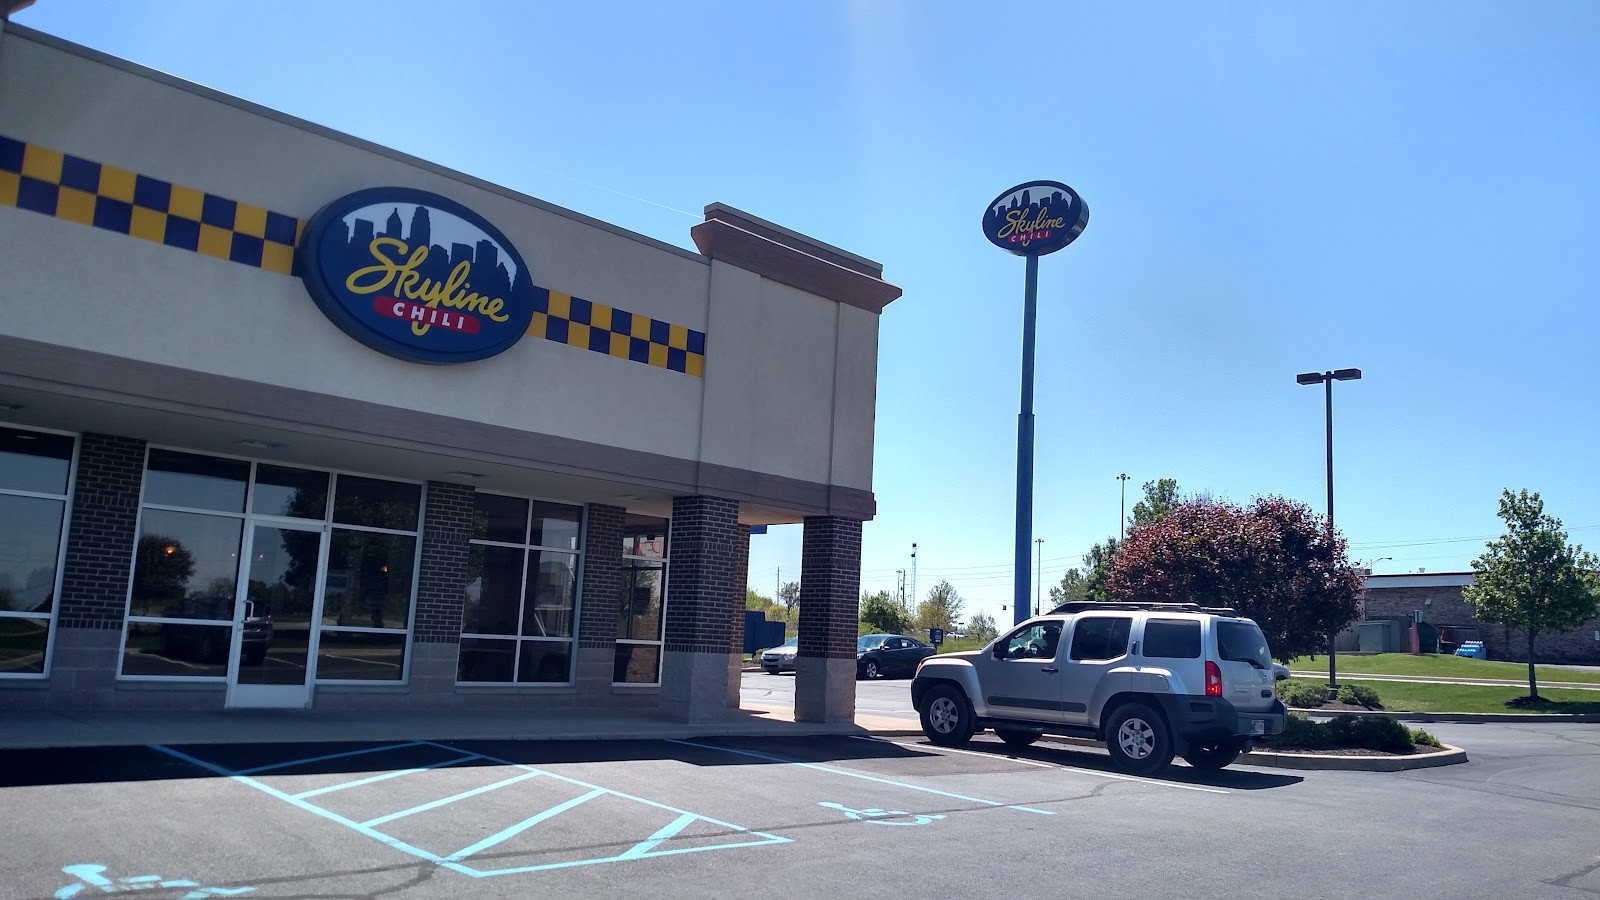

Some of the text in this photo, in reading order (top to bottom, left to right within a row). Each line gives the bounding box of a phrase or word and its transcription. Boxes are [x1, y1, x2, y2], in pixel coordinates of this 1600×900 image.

[998, 207, 1065, 246] Skyline
[1011, 231, 1050, 242] CHILI
[346, 237, 509, 336] Skyline
[392, 302, 465, 330] CHILI
